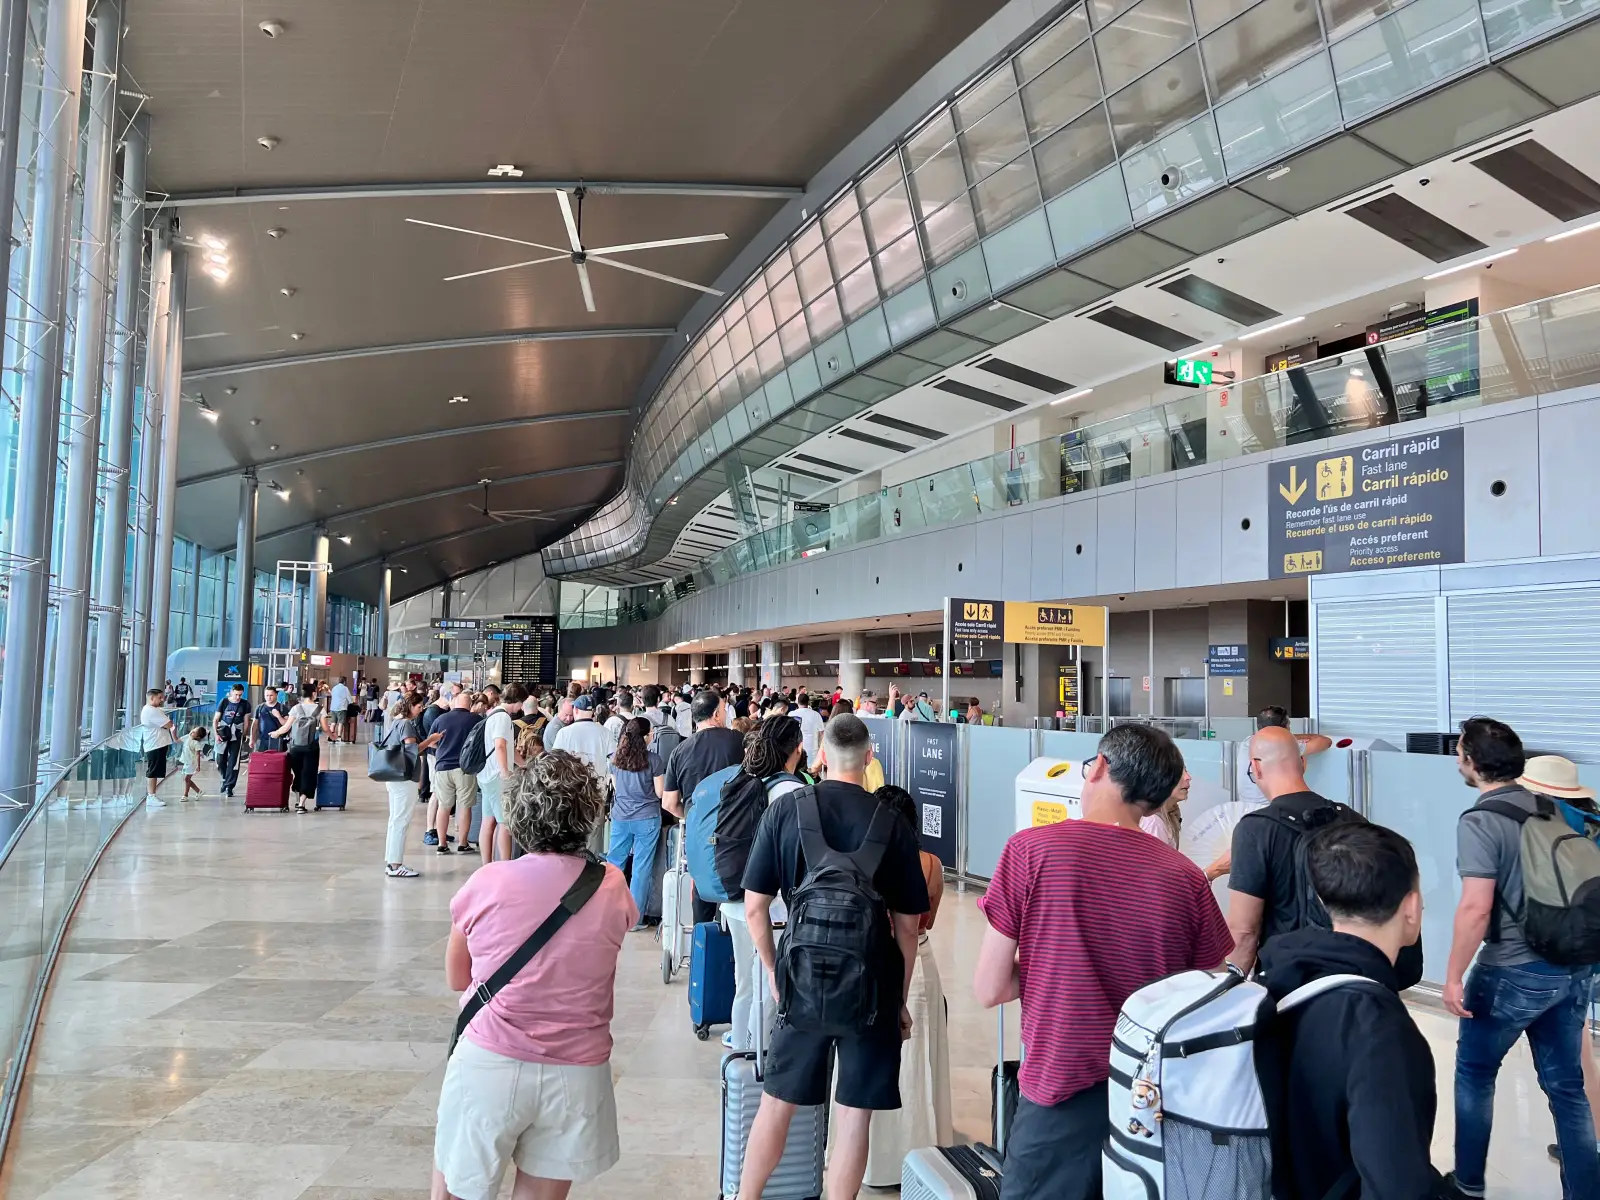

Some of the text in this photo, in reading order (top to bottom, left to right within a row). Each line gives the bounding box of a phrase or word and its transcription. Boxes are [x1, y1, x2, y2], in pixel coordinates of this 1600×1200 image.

[1362, 436, 1440, 461] Carril ràpid
[1362, 461, 1407, 476] Fast lane
[1362, 468, 1449, 491] Carril rápido
[1286, 494, 1407, 520] Recorde l'ús de carril ràpid
[1286, 512, 1366, 529] Remember fast lane use
[1286, 512, 1432, 539] Recuerde el uso de carril rápido
[1350, 529, 1428, 546] Accés preferent
[1350, 544, 1398, 556] Priority access
[1350, 550, 1441, 566] Acceso preferente
[929, 646, 936, 657] 43
[935, 666, 941, 674] 46
[922, 746, 942, 760] LANE
